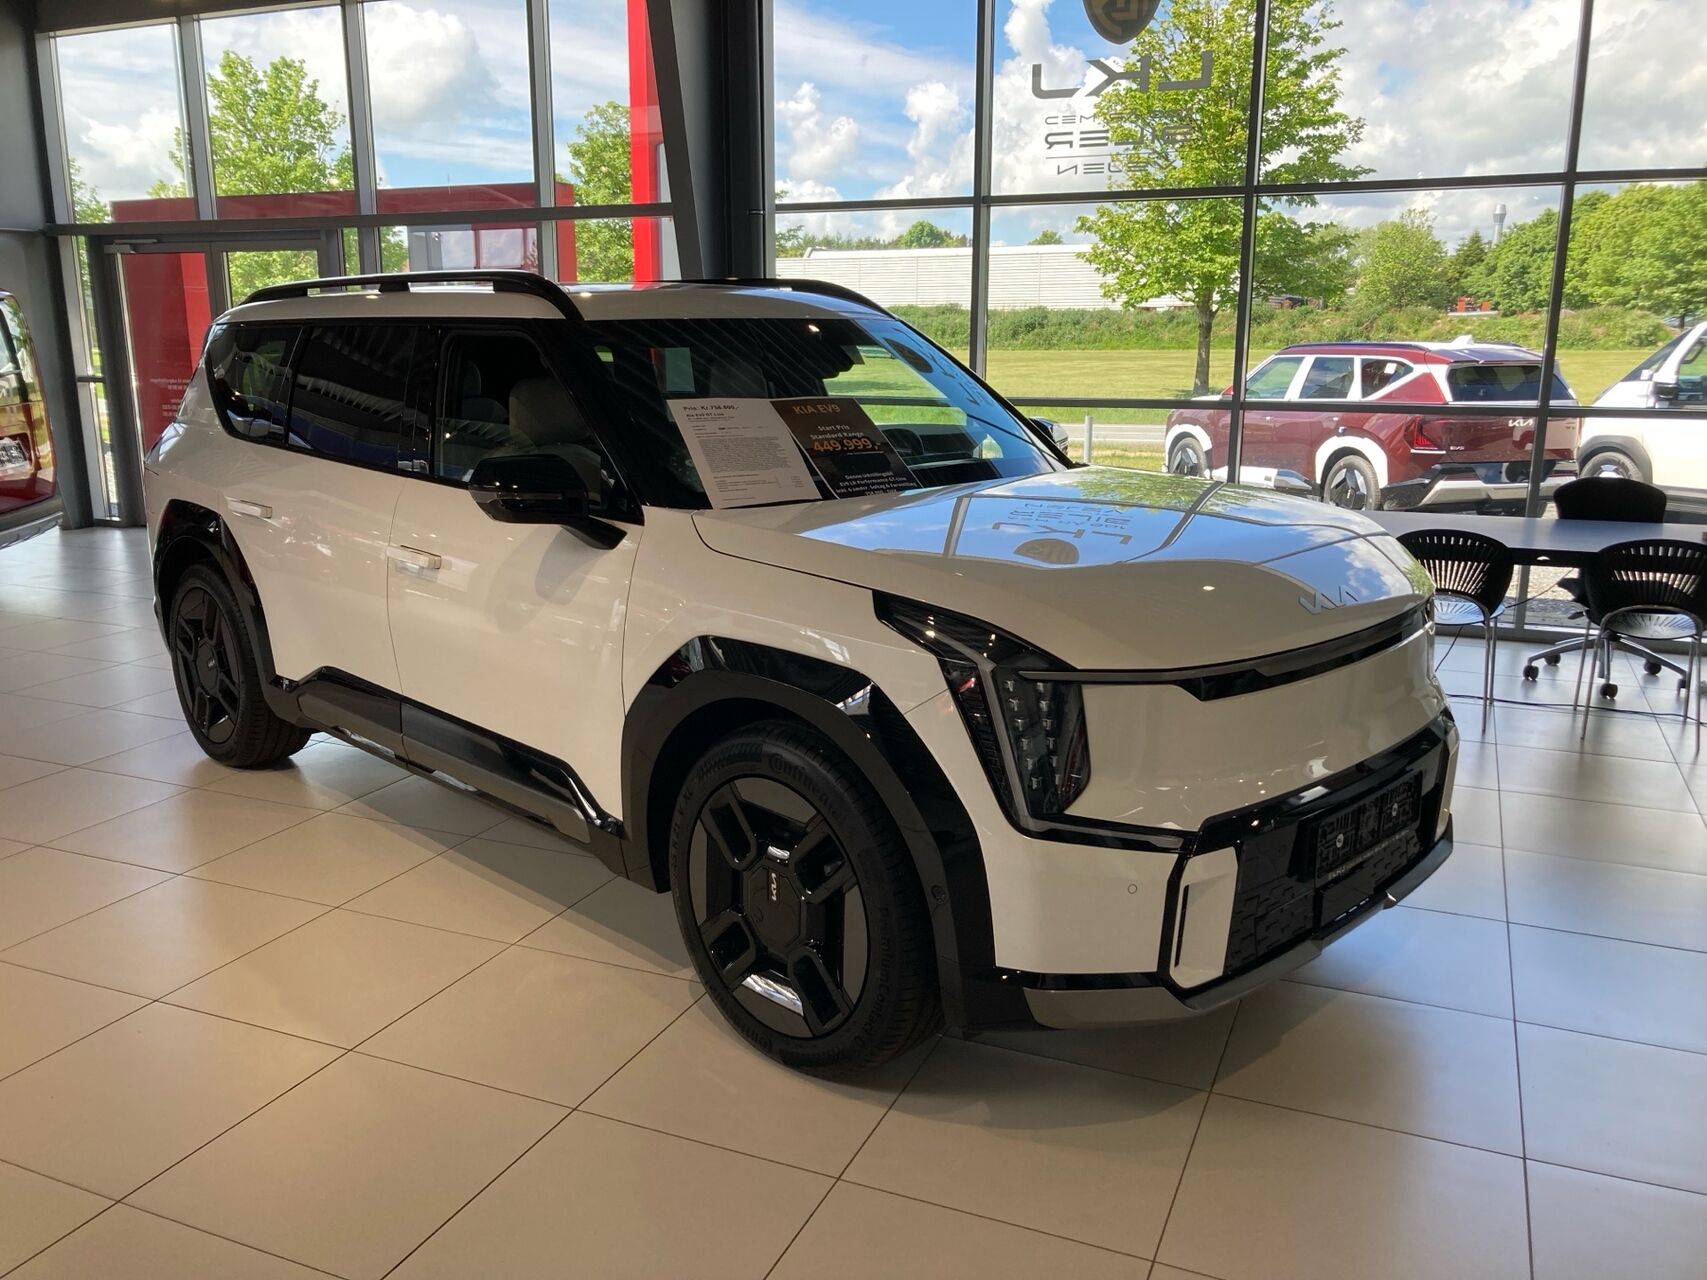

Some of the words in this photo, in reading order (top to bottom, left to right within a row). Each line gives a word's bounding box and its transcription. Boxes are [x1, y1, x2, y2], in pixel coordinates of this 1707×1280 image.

[793, 405, 816, 415] KIA
[818, 404, 840, 413] EV9
[843, 431, 865, 439] Range
